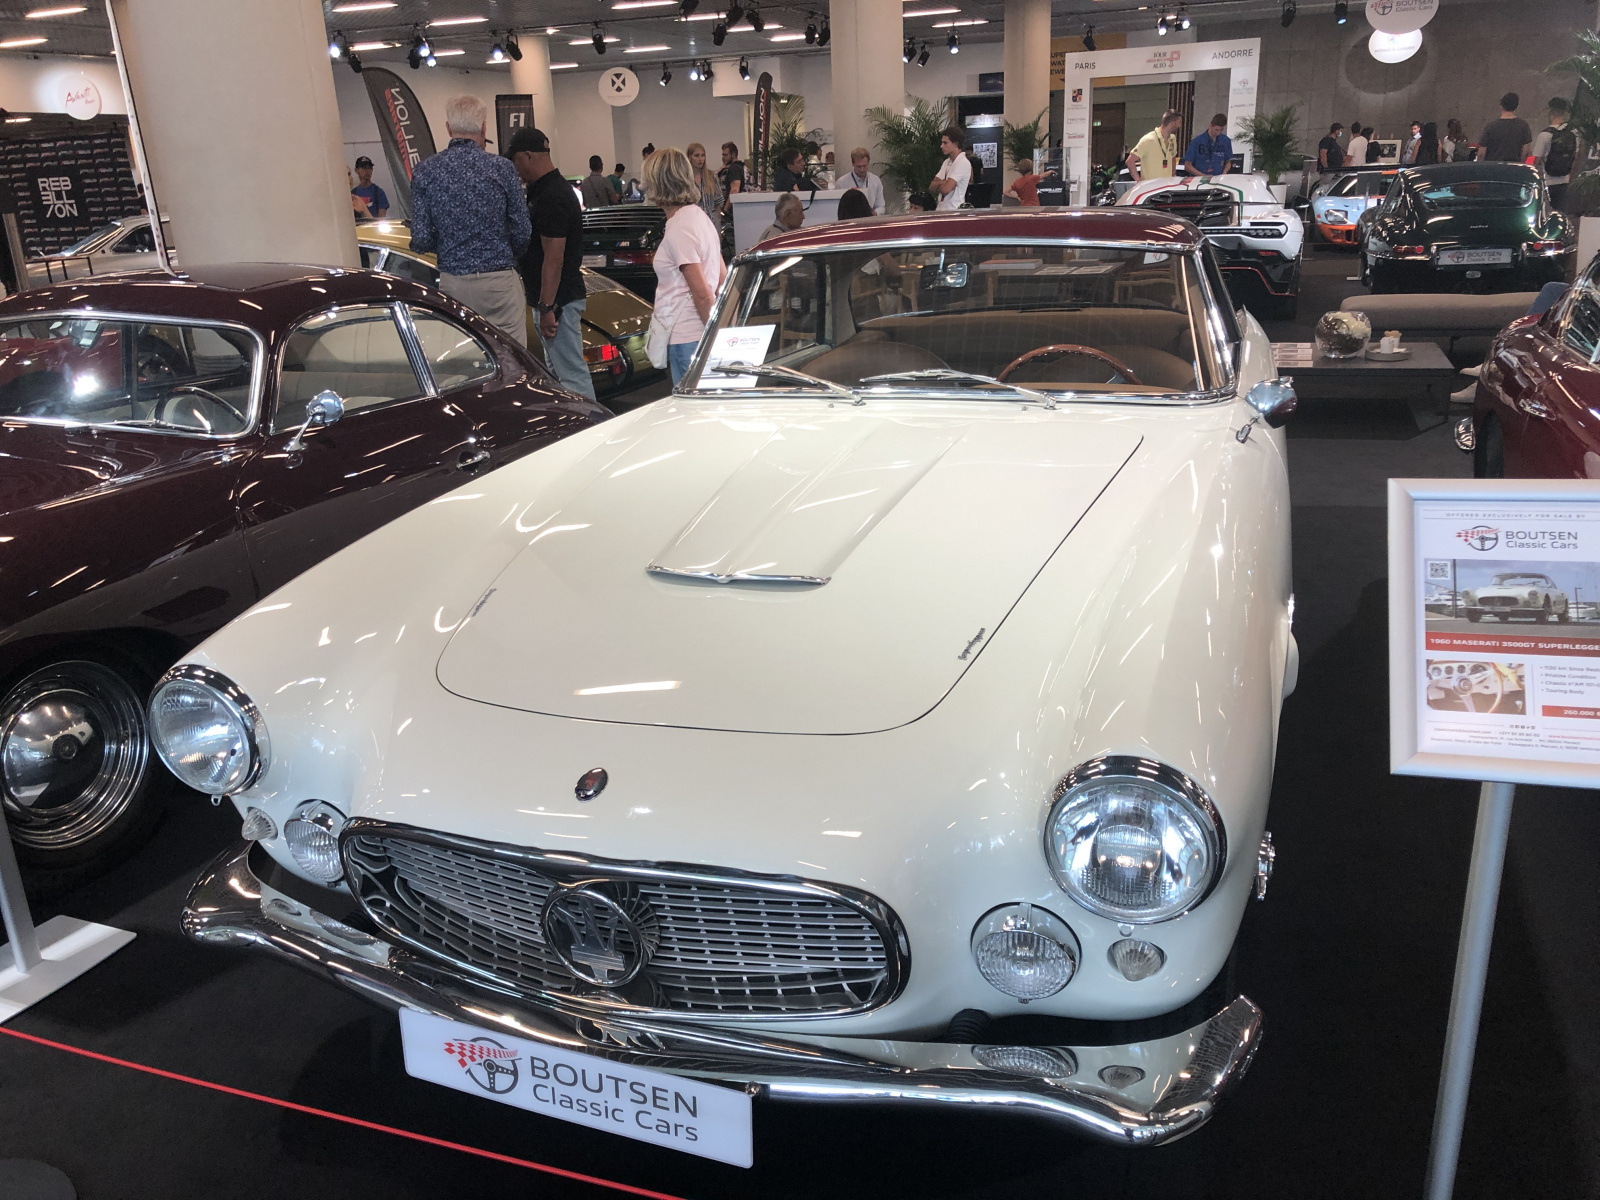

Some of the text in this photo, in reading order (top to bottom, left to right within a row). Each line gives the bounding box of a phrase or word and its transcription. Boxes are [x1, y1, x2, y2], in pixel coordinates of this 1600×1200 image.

[1212, 49, 1253, 60] ANDORRE
[1075, 62, 1096, 70] PARIS
[510, 112, 525, 128] F1
[1505, 530, 1578, 540] BOUTSEN
[1506, 541, 1579, 549] Classic Cars
[1453, 639, 1499, 647] MASERATI
[530, 1055, 699, 1118] BOUTSEN
[532, 1083, 699, 1142] Classic Cars
